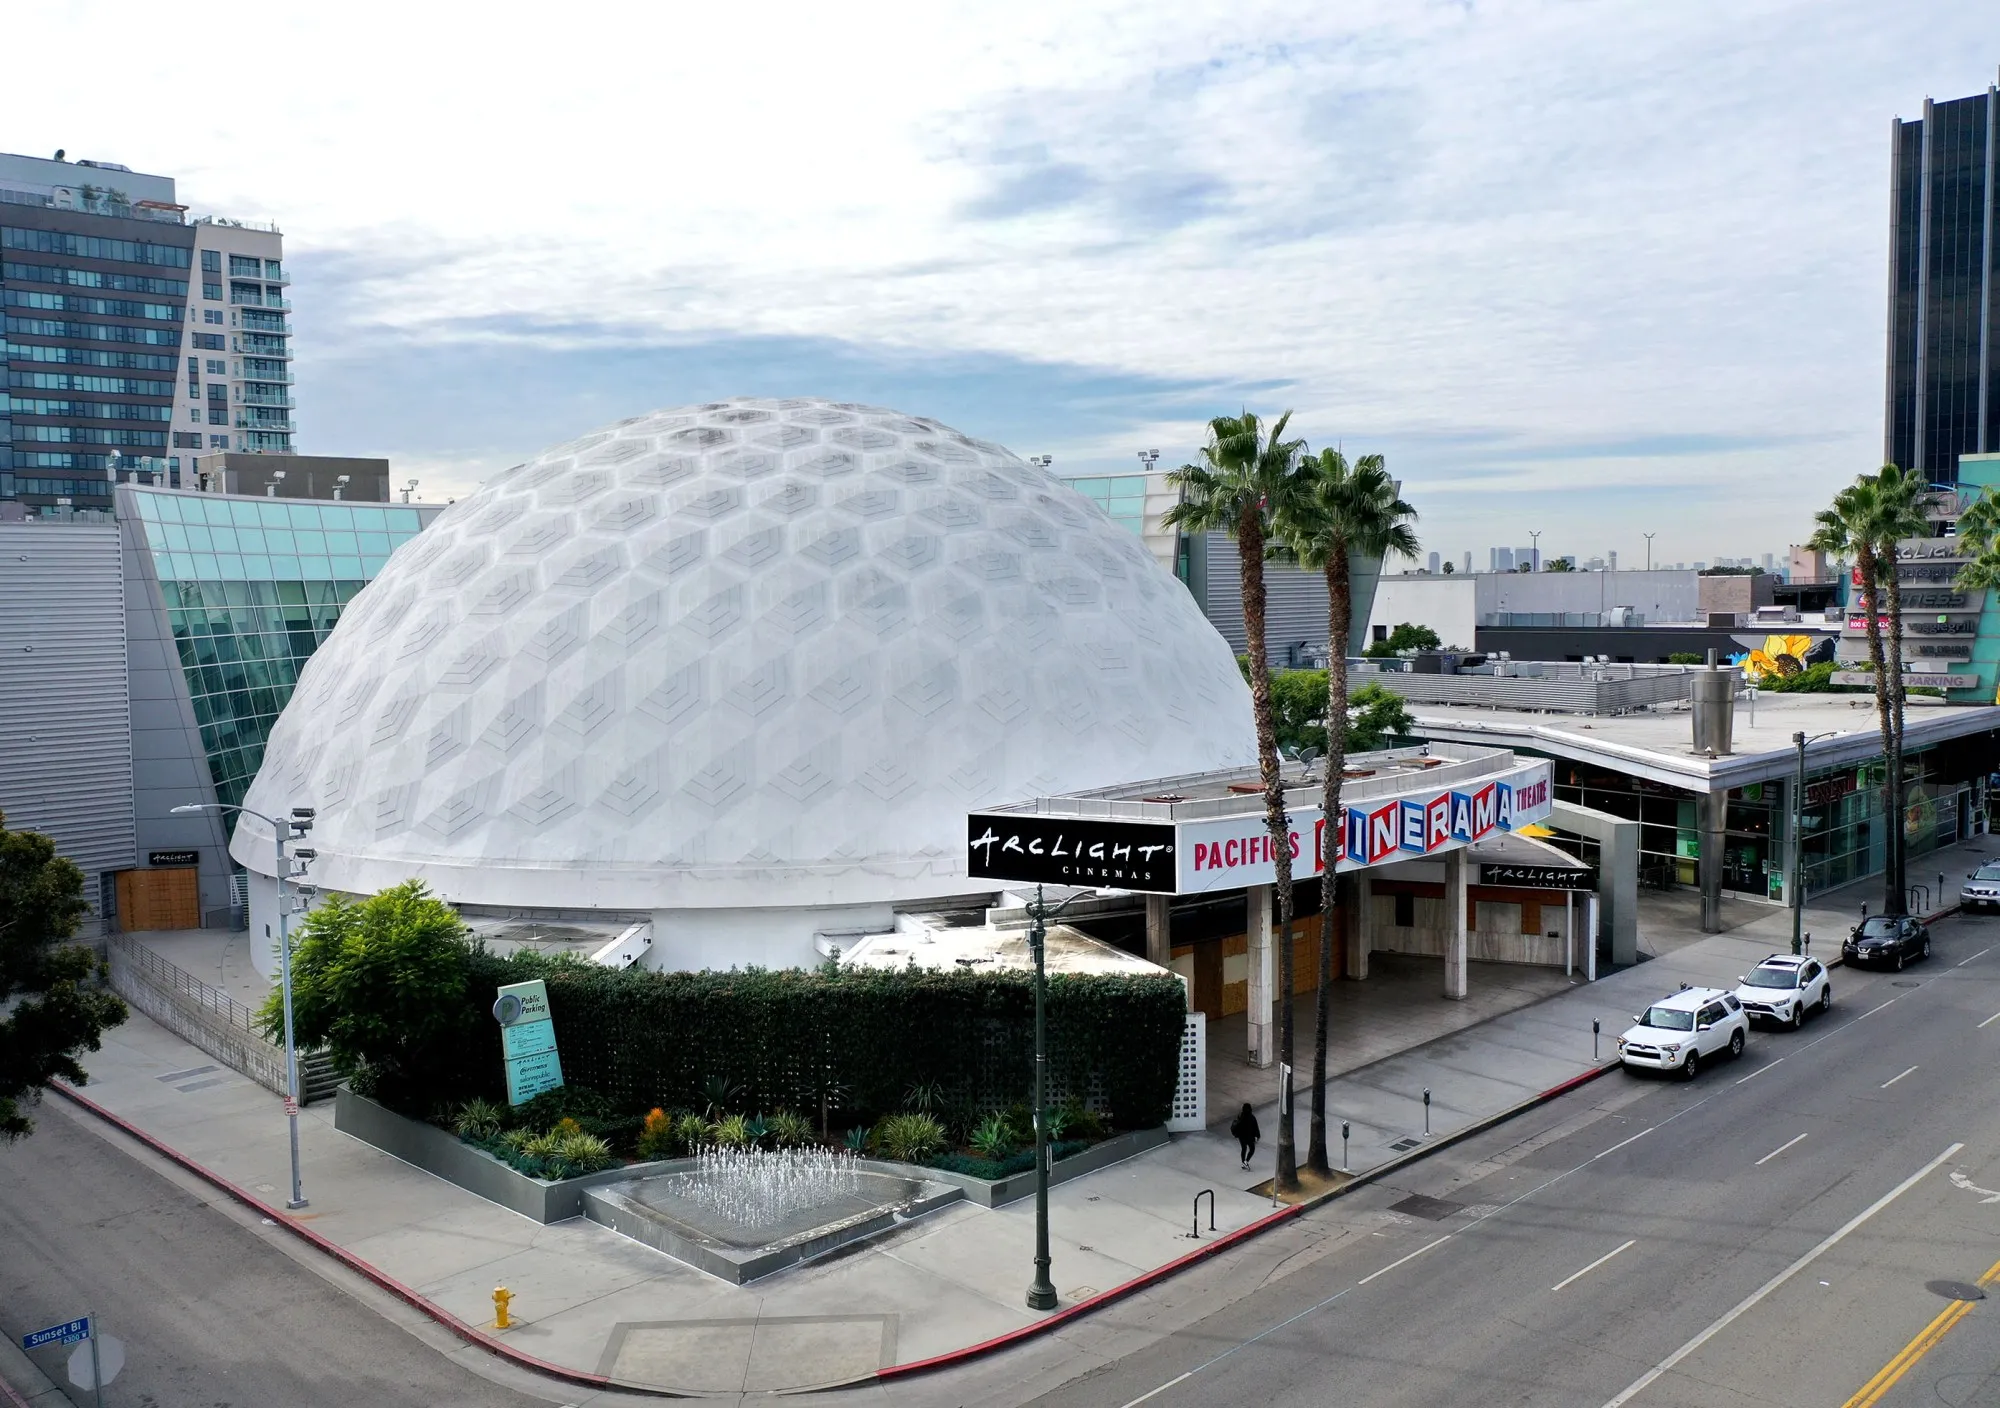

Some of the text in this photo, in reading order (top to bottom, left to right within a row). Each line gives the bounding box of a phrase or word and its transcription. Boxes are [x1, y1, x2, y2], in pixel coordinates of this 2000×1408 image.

[1908, 675, 1965, 687] PARKING
[1516, 779, 1548, 813] THEATRE
[1062, 865, 1151, 880] CINEMAS
[1486, 865, 1584, 884] ARCLIGHT
[521, 995, 540, 1005] Public
[521, 1003, 546, 1015] Parking
[31, 1321, 81, 1344] Sunset Bl
[63, 1334, 80, 1344] 6300
